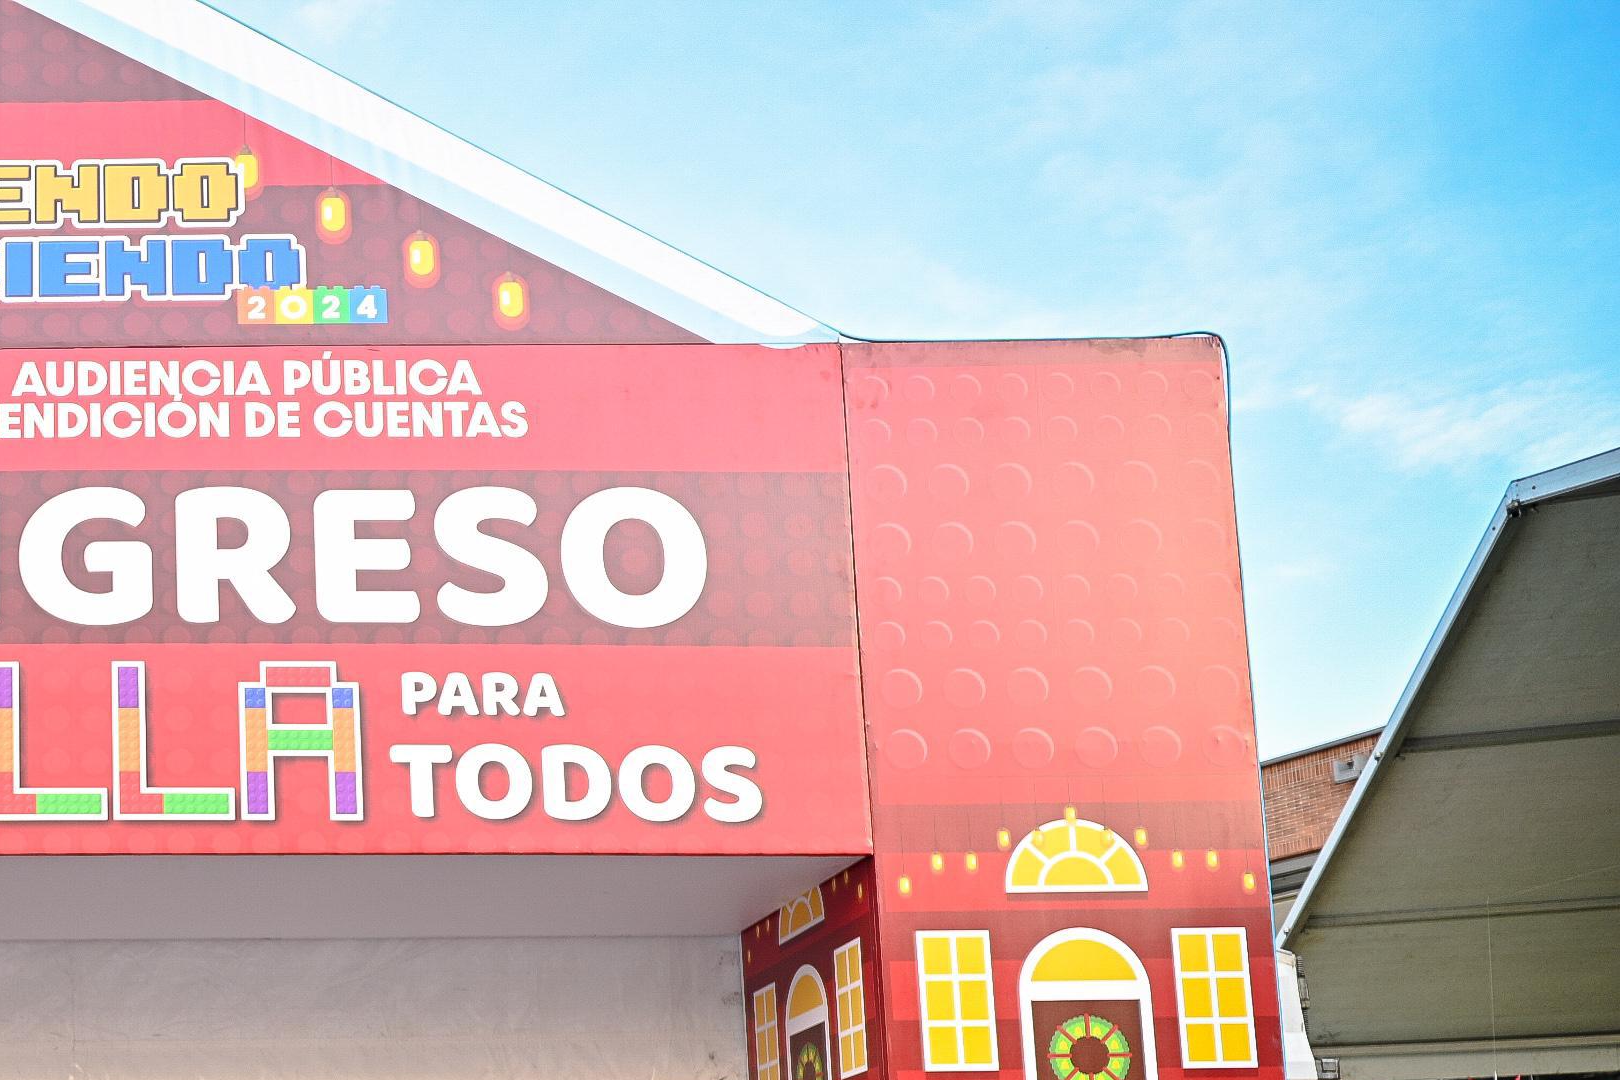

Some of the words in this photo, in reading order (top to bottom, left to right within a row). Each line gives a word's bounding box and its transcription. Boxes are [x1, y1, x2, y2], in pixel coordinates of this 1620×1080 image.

[246, 292, 378, 320] 2024
[11, 359, 272, 399] AUDIENCIA
[283, 350, 483, 396] PÚBLICA
[244, 401, 301, 438] DE
[313, 400, 529, 438] CUENTAS
[401, 671, 566, 717] PARA
[389, 743, 763, 823] TODOS
